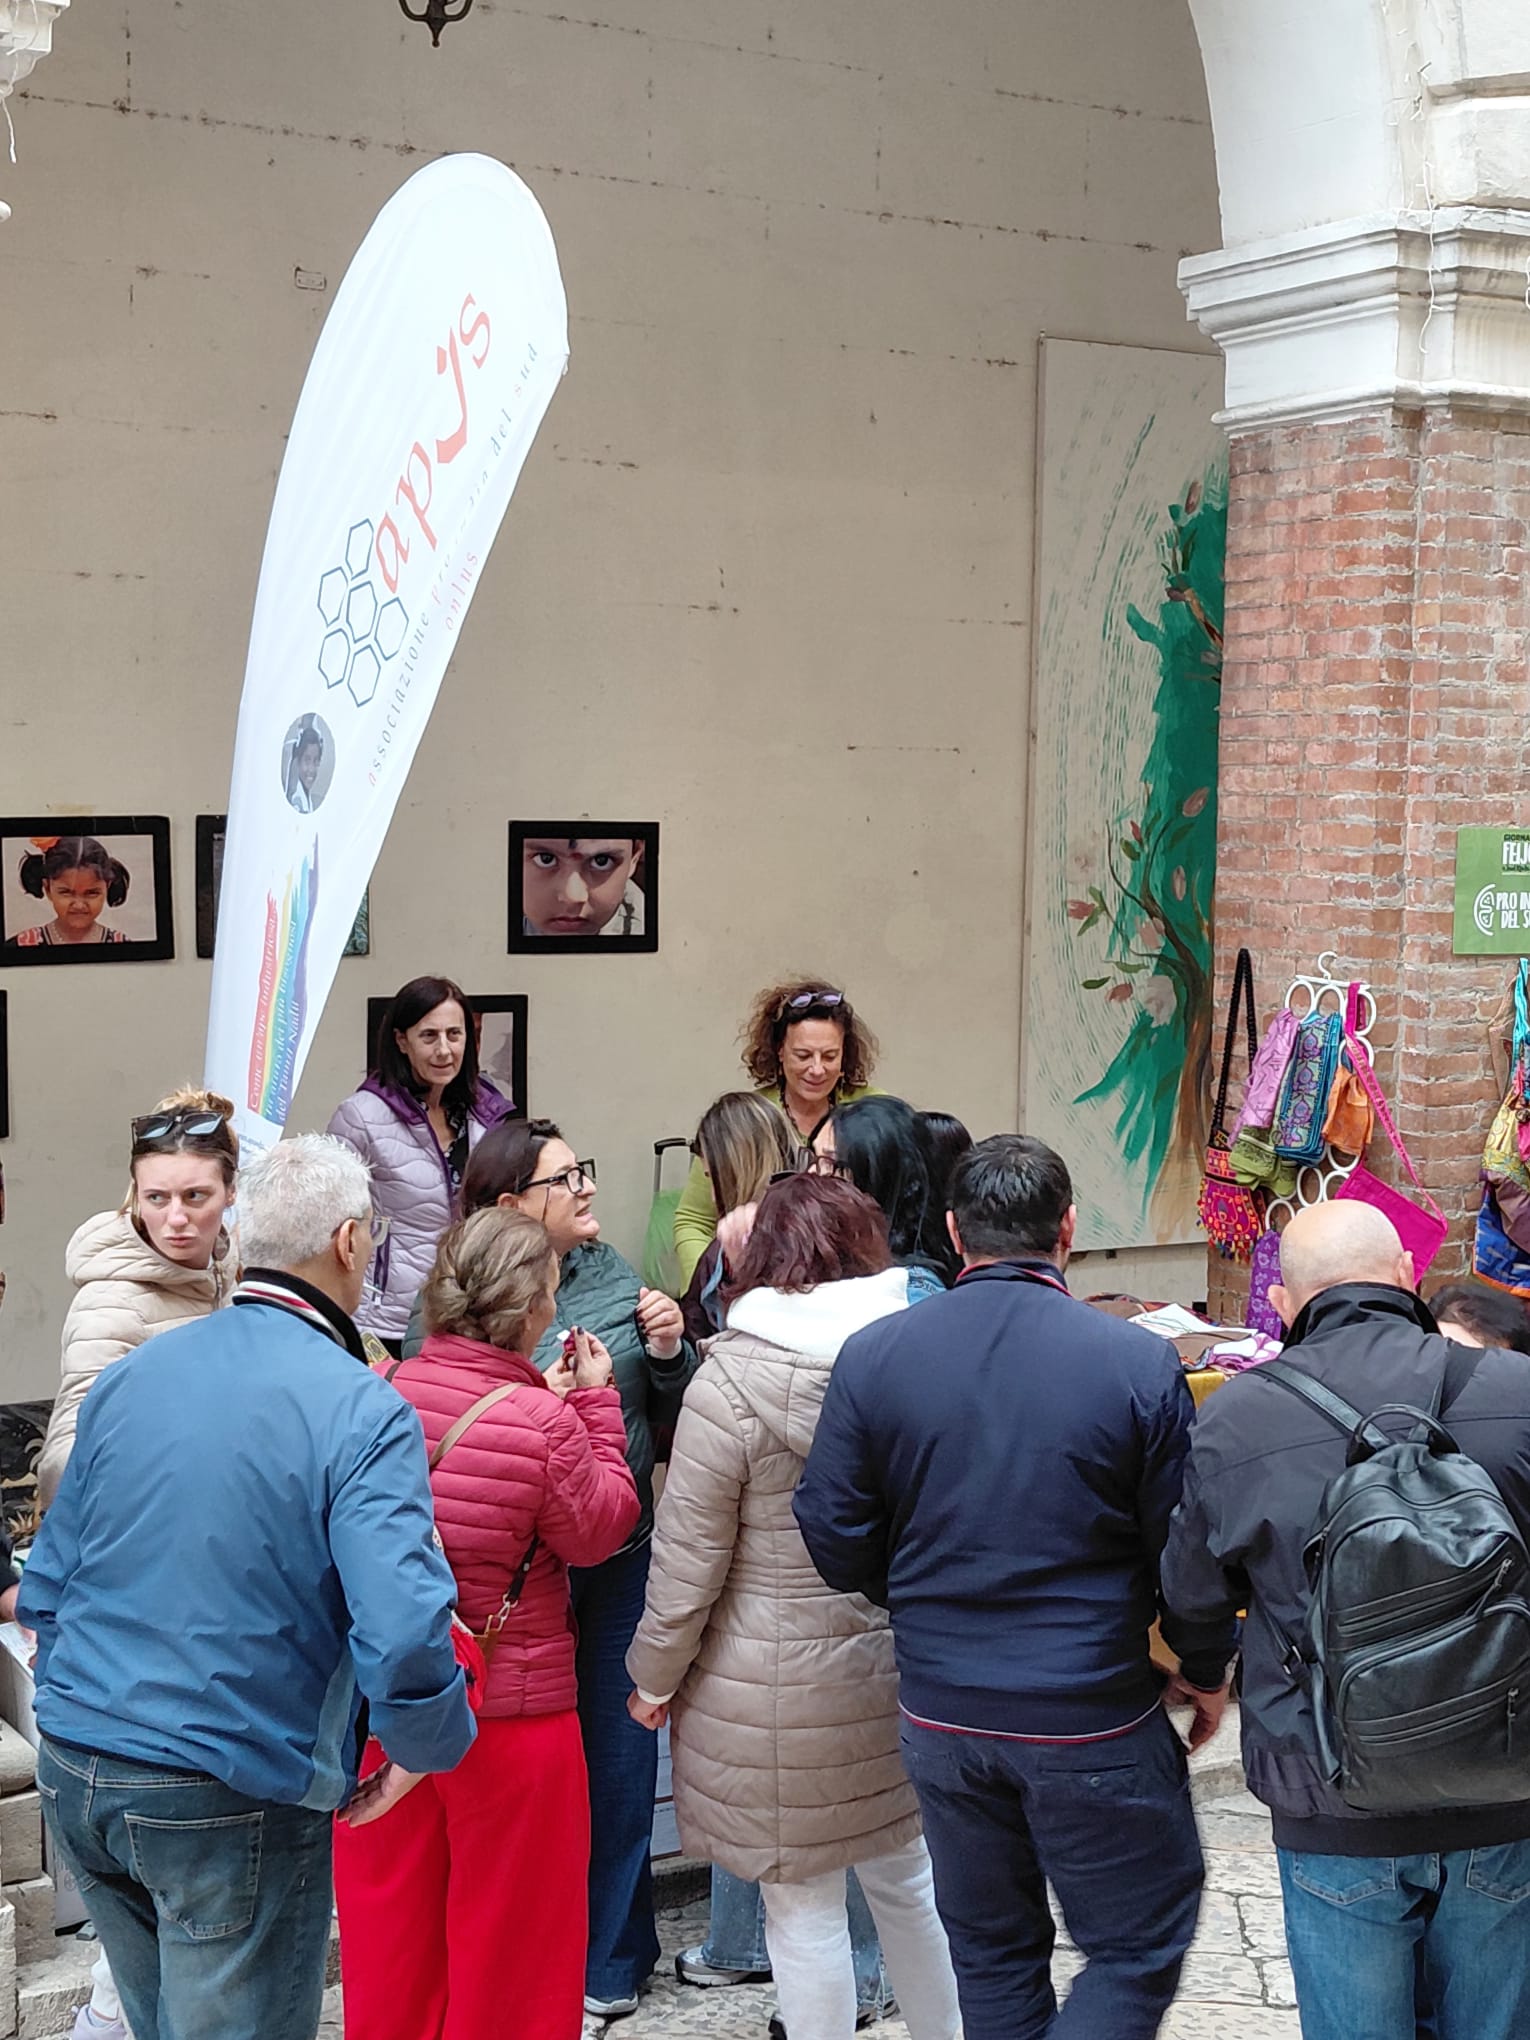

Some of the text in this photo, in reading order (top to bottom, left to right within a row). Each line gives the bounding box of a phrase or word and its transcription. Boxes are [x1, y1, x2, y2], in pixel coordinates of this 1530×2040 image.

[368, 612, 429, 787] associazione
[490, 408, 512, 456] del
[445, 552, 478, 631] onlus
[1503, 842, 1530, 865] FEIJ
[1496, 892, 1518, 911] PRO
[1501, 910, 1520, 928] DEL
[251, 1067, 262, 1108] Come
[275, 1096, 287, 1121] del
